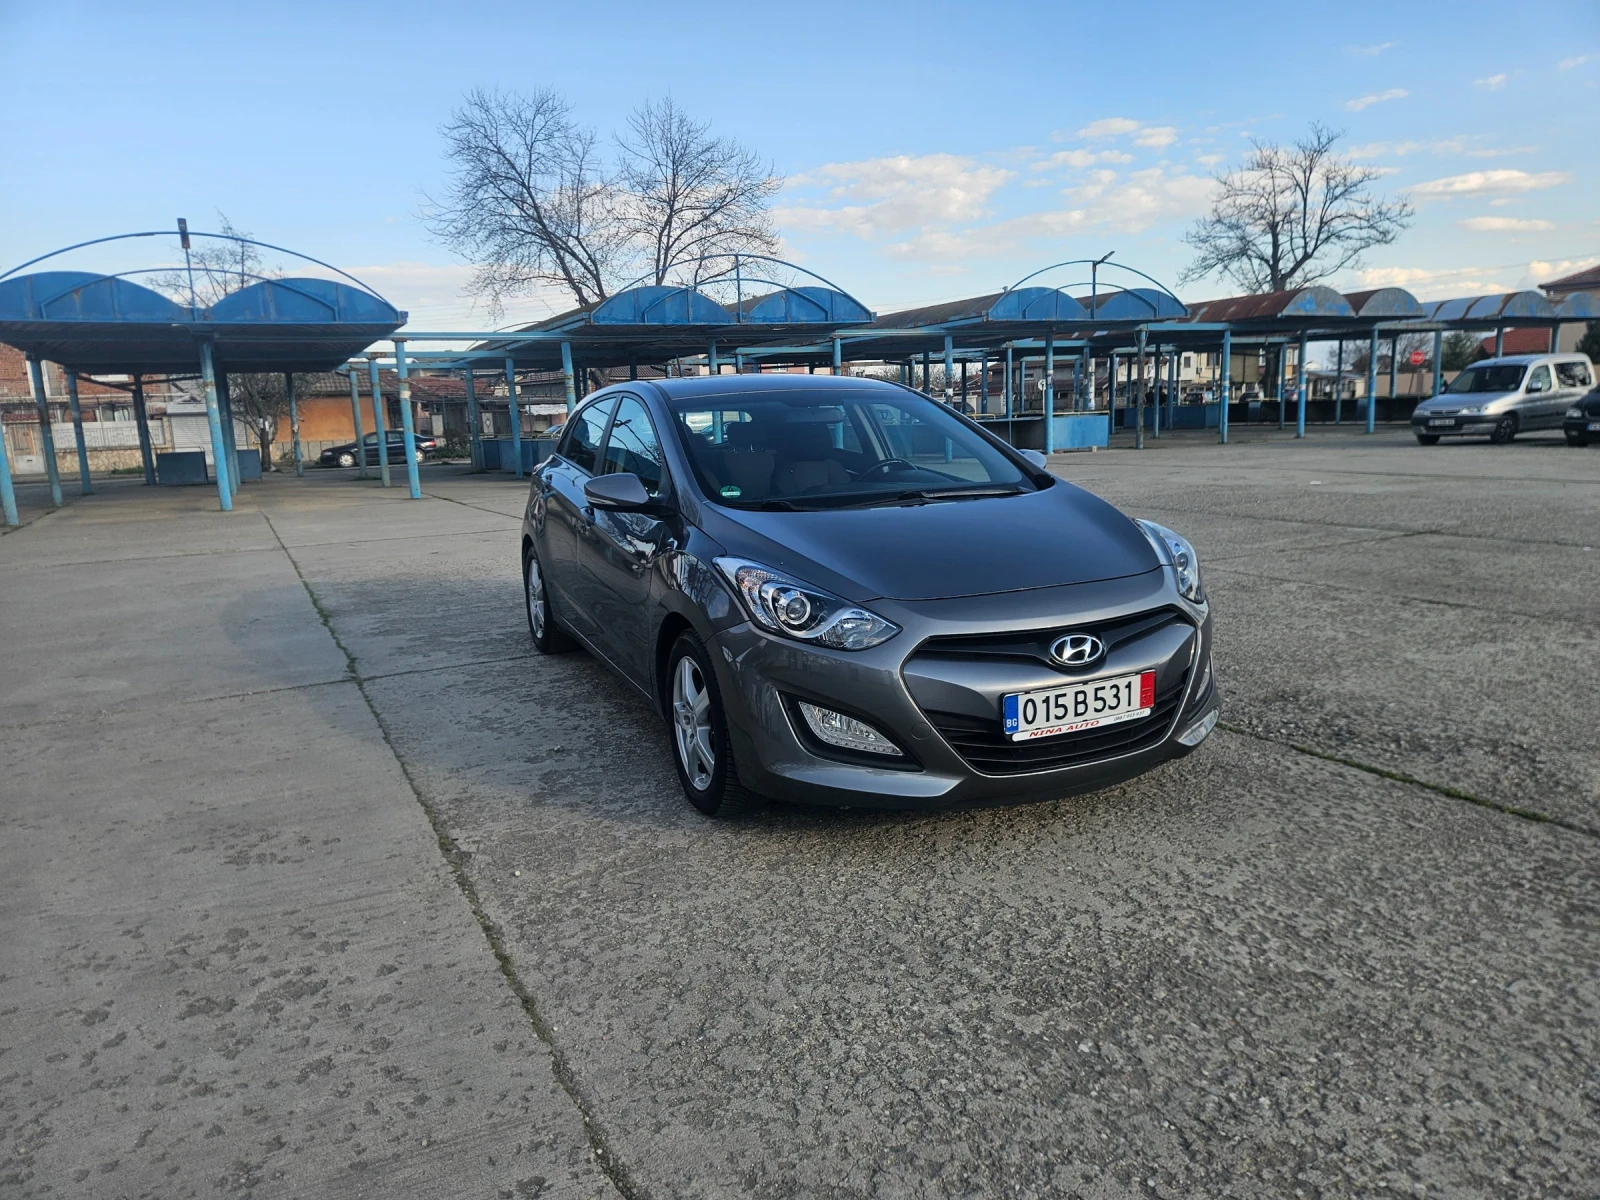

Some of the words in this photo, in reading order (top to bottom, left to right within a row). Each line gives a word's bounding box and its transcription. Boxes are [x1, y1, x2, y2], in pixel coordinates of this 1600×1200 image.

[1006, 718, 1018, 728] BG
[1029, 727, 1062, 738] NINA
[1066, 720, 1100, 732] AUTO
